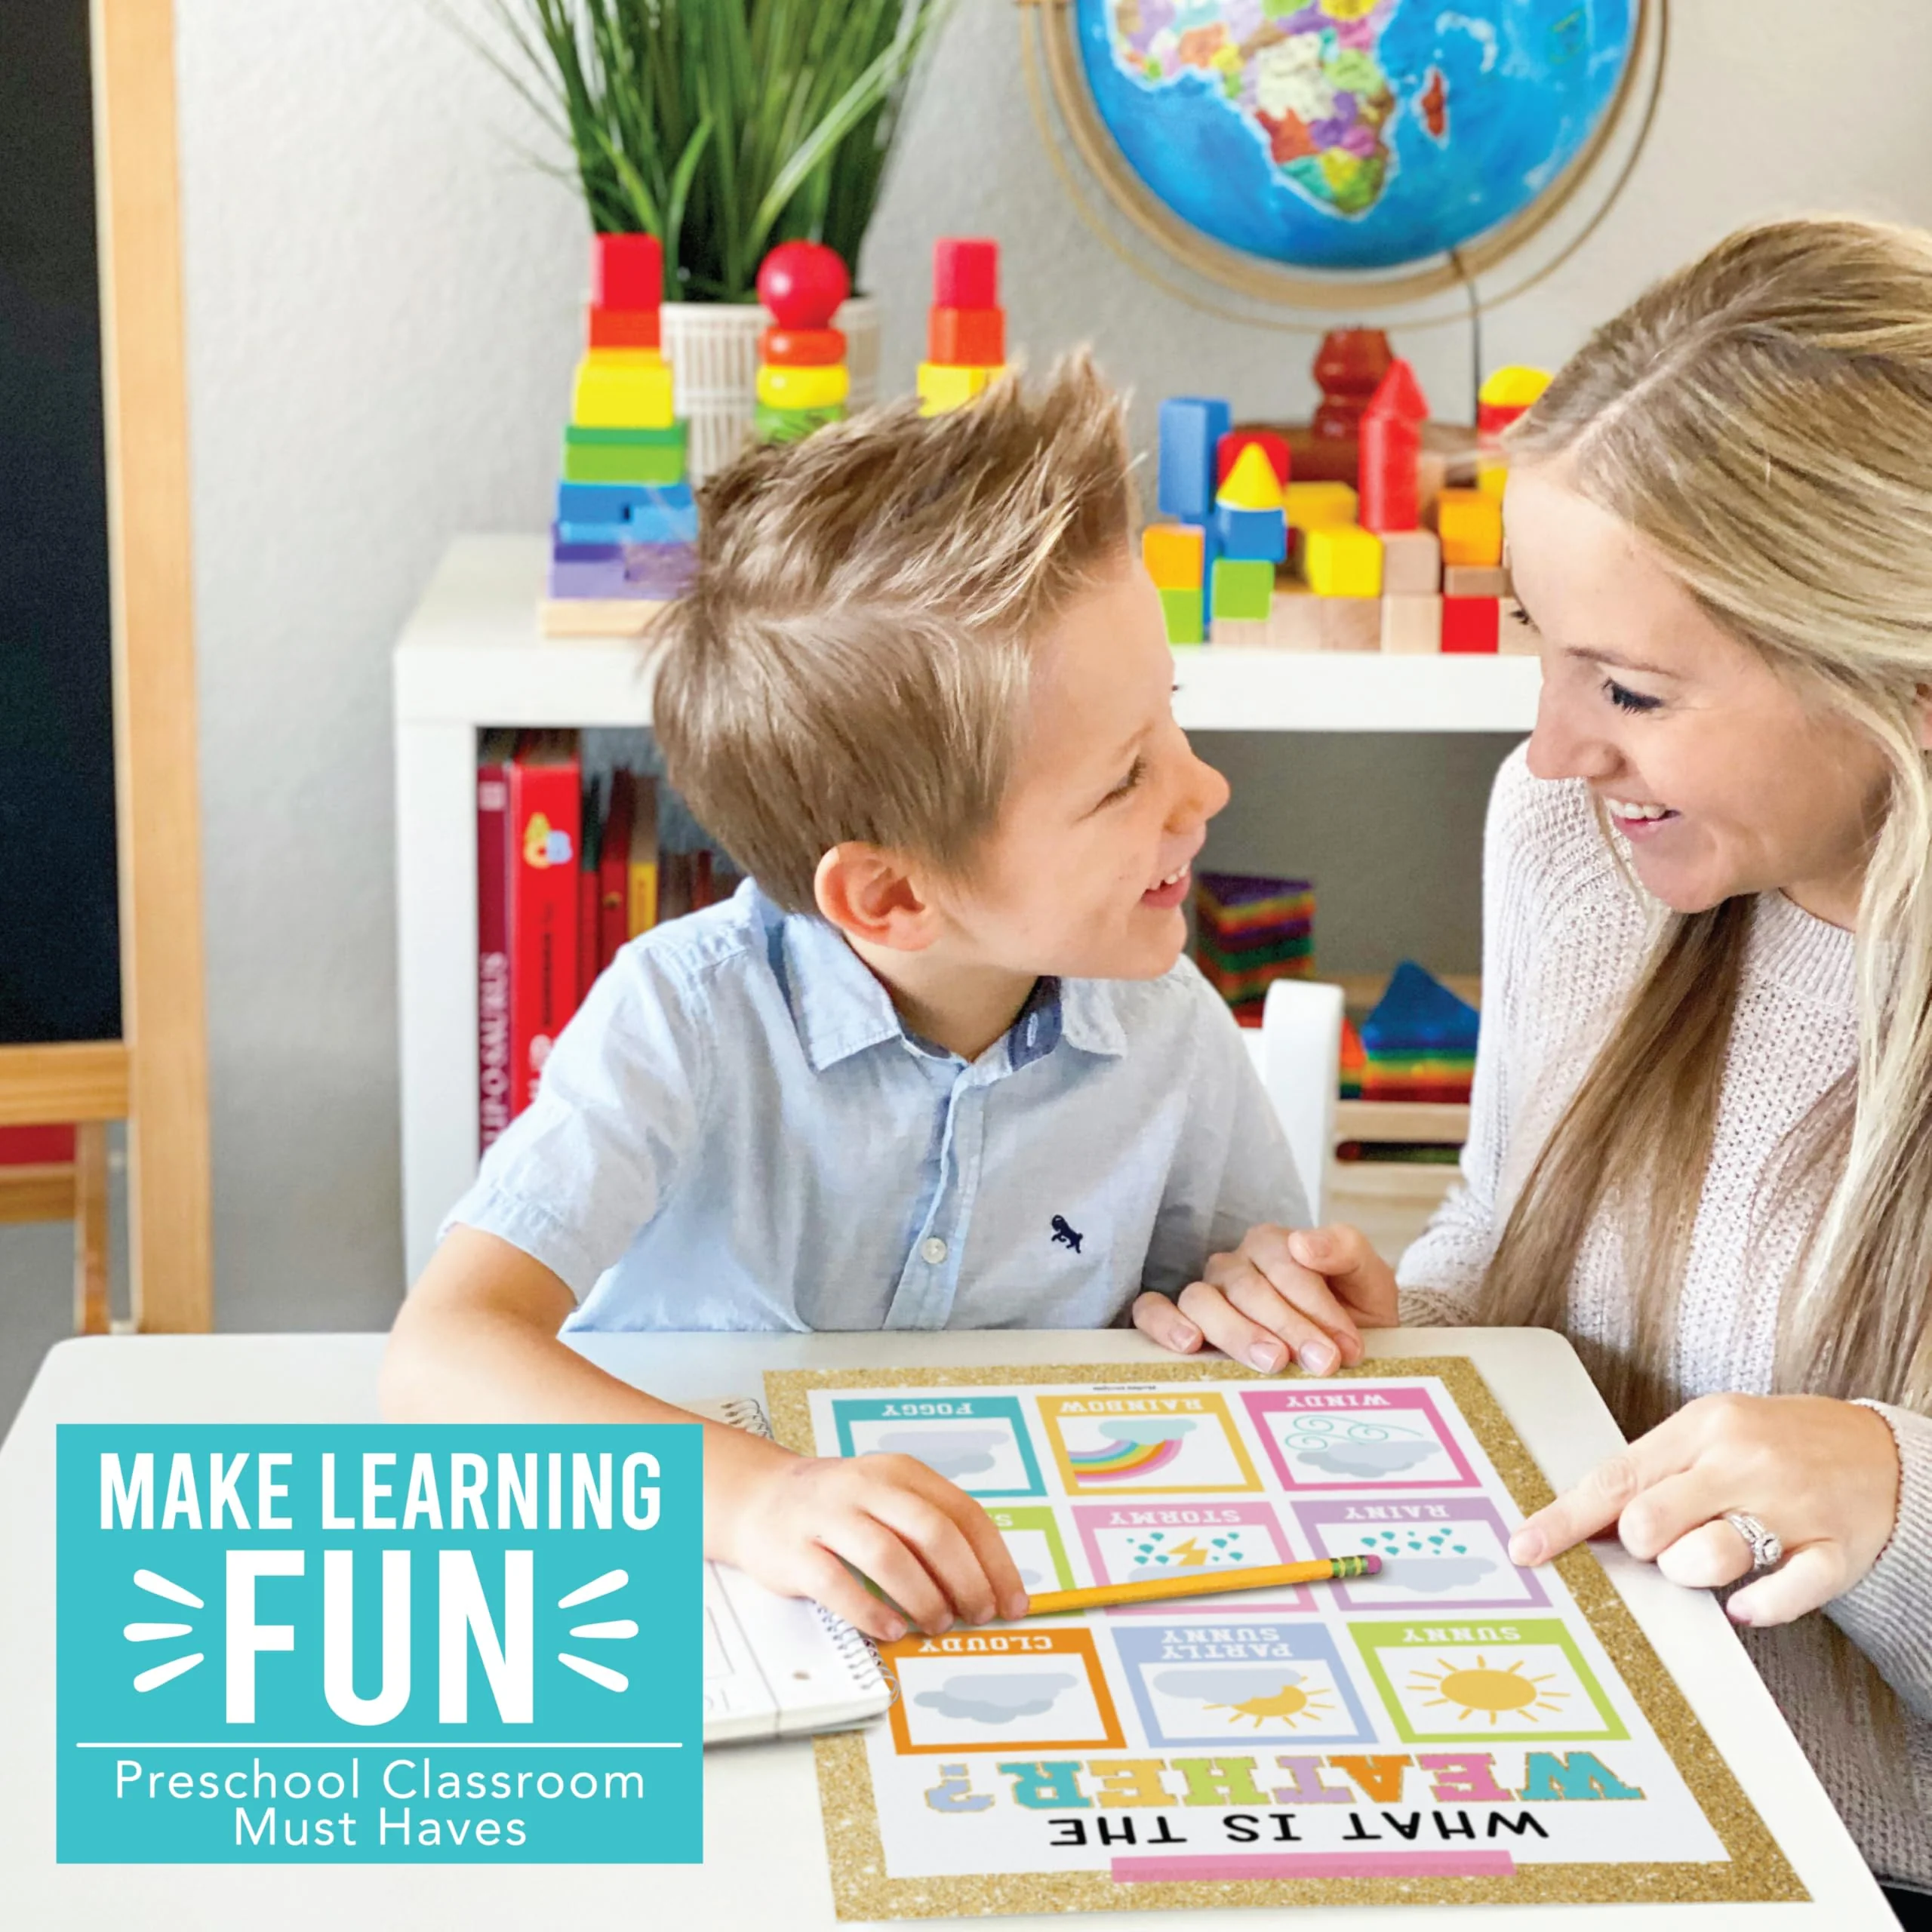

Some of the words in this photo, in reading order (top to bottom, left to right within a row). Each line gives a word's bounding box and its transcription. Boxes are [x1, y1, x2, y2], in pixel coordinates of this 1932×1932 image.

[1061, 1398, 1204, 1413] RAINBOW
[1286, 1394, 1390, 1408] WINDY
[882, 1402, 974, 1417] FOGGY
[1109, 1509, 1241, 1525] STORMY
[1345, 1504, 1449, 1520] RAINY
[1161, 1628, 1279, 1644] SUNNY
[1403, 1626, 1521, 1643] SUNNY
[918, 1636, 1053, 1652] CLOUDY
[1161, 1643, 1293, 1660] PARTLY
[924, 1751, 1646, 1813] WEATHER?
[1048, 1815, 1188, 1846] THE
[1223, 1813, 1302, 1842] IS
[1343, 1810, 1549, 1841] WHAT
